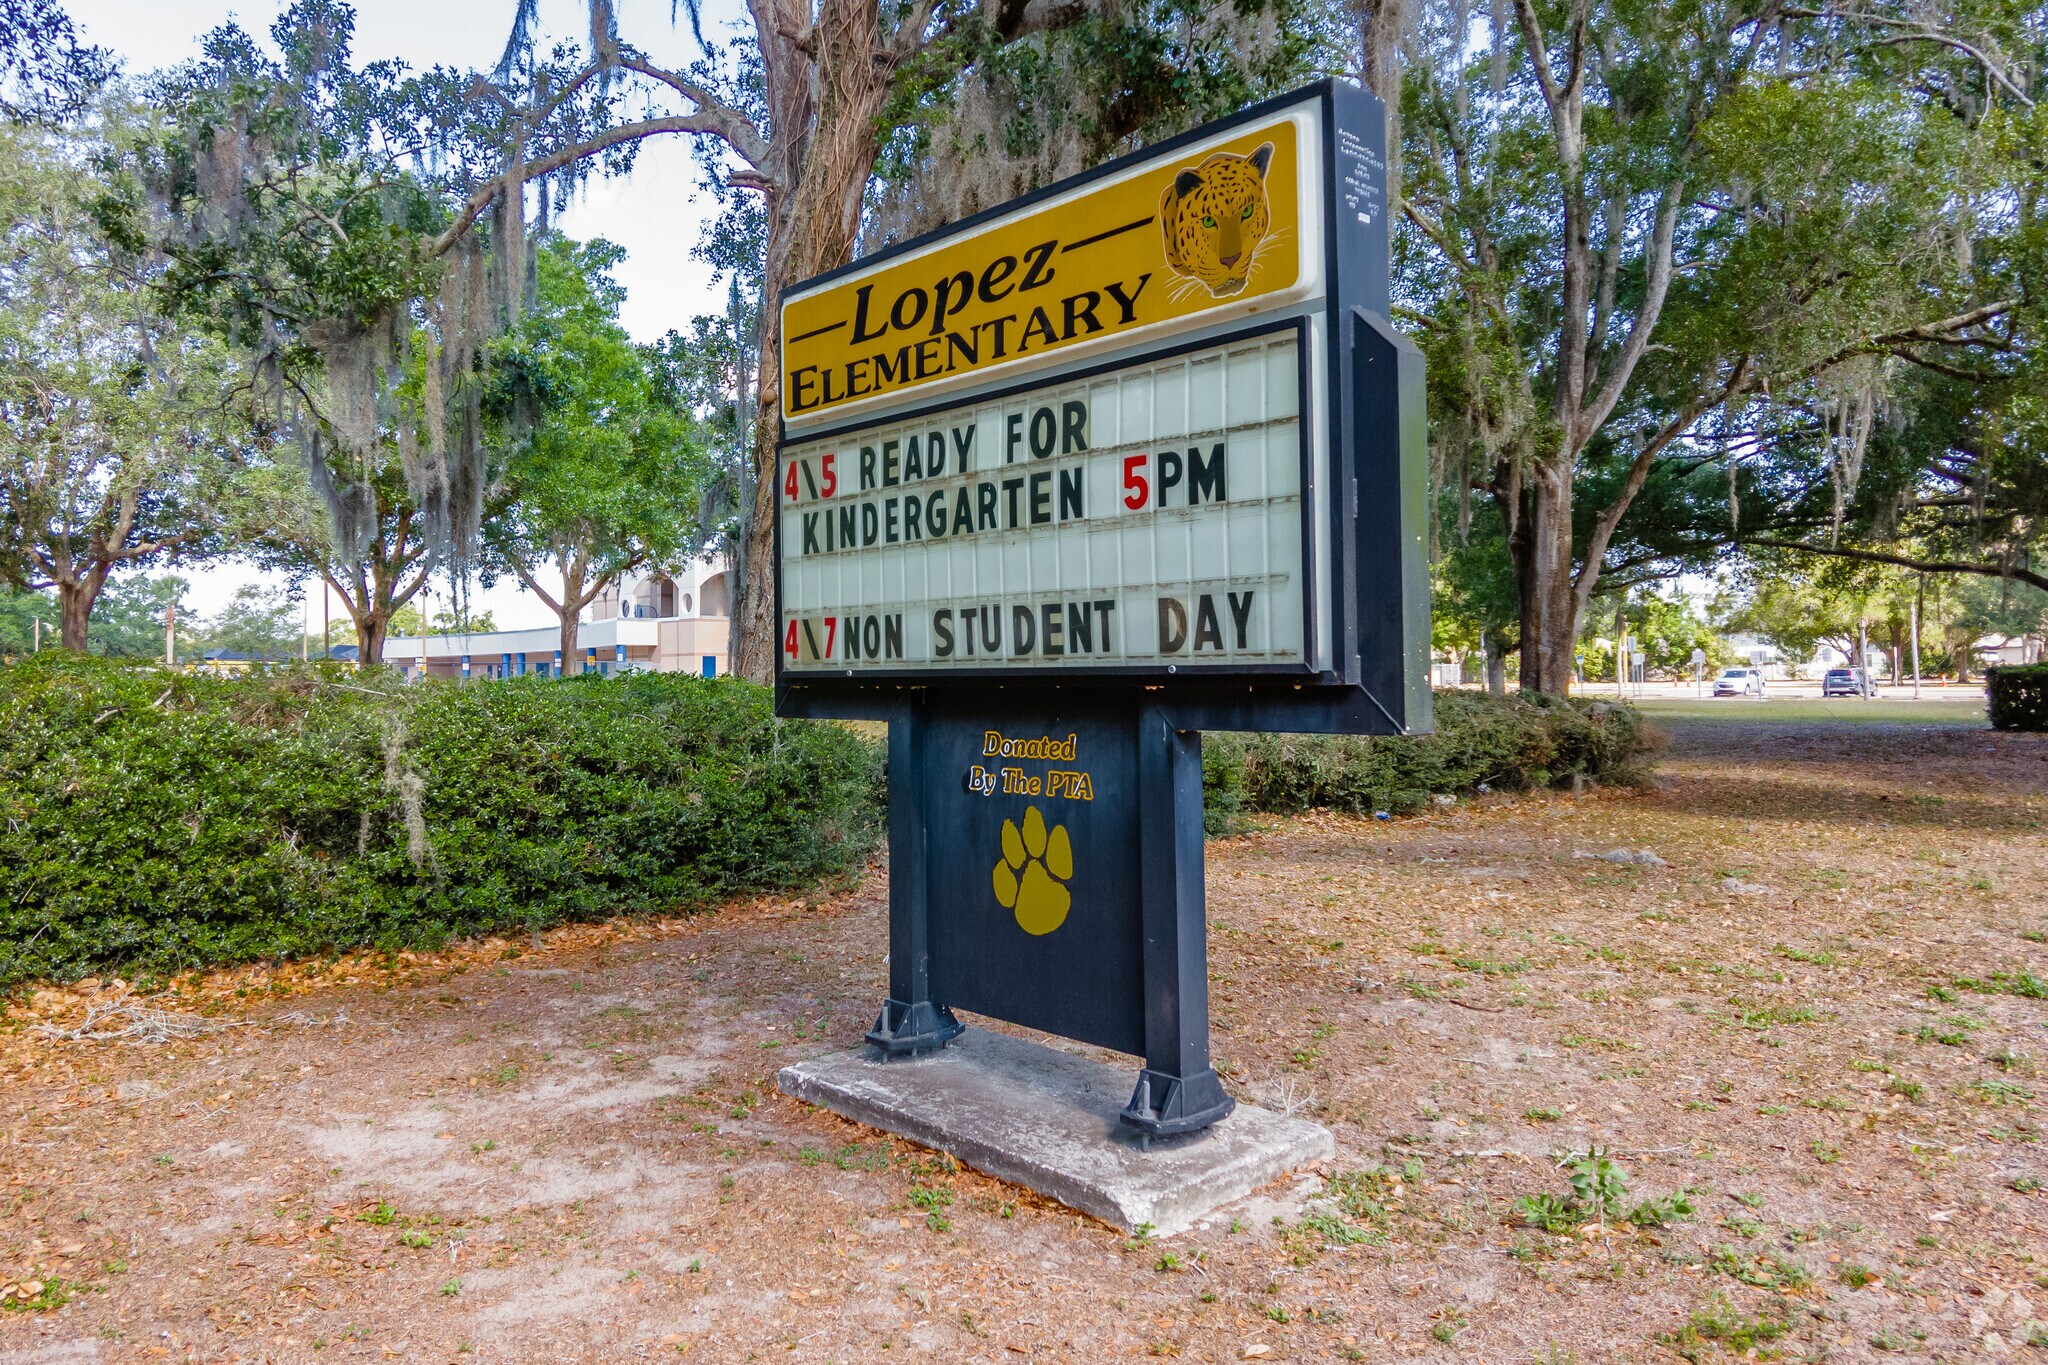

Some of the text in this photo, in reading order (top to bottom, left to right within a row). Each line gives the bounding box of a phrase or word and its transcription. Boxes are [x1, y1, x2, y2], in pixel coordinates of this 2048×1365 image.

[789, 272, 1152, 412] ELEMENTARY
[849, 239, 1059, 346] Lopez
[785, 400, 1088, 502] 4\5 READY FOR
[803, 442, 1227, 556] KINDERGARTEN 5PM
[844, 613, 902, 660] NON
[933, 599, 1115, 657] STUDENT
[1157, 590, 1254, 654] DAY
[969, 765, 1094, 801] By The PTA
[982, 730, 1077, 761] Donated
